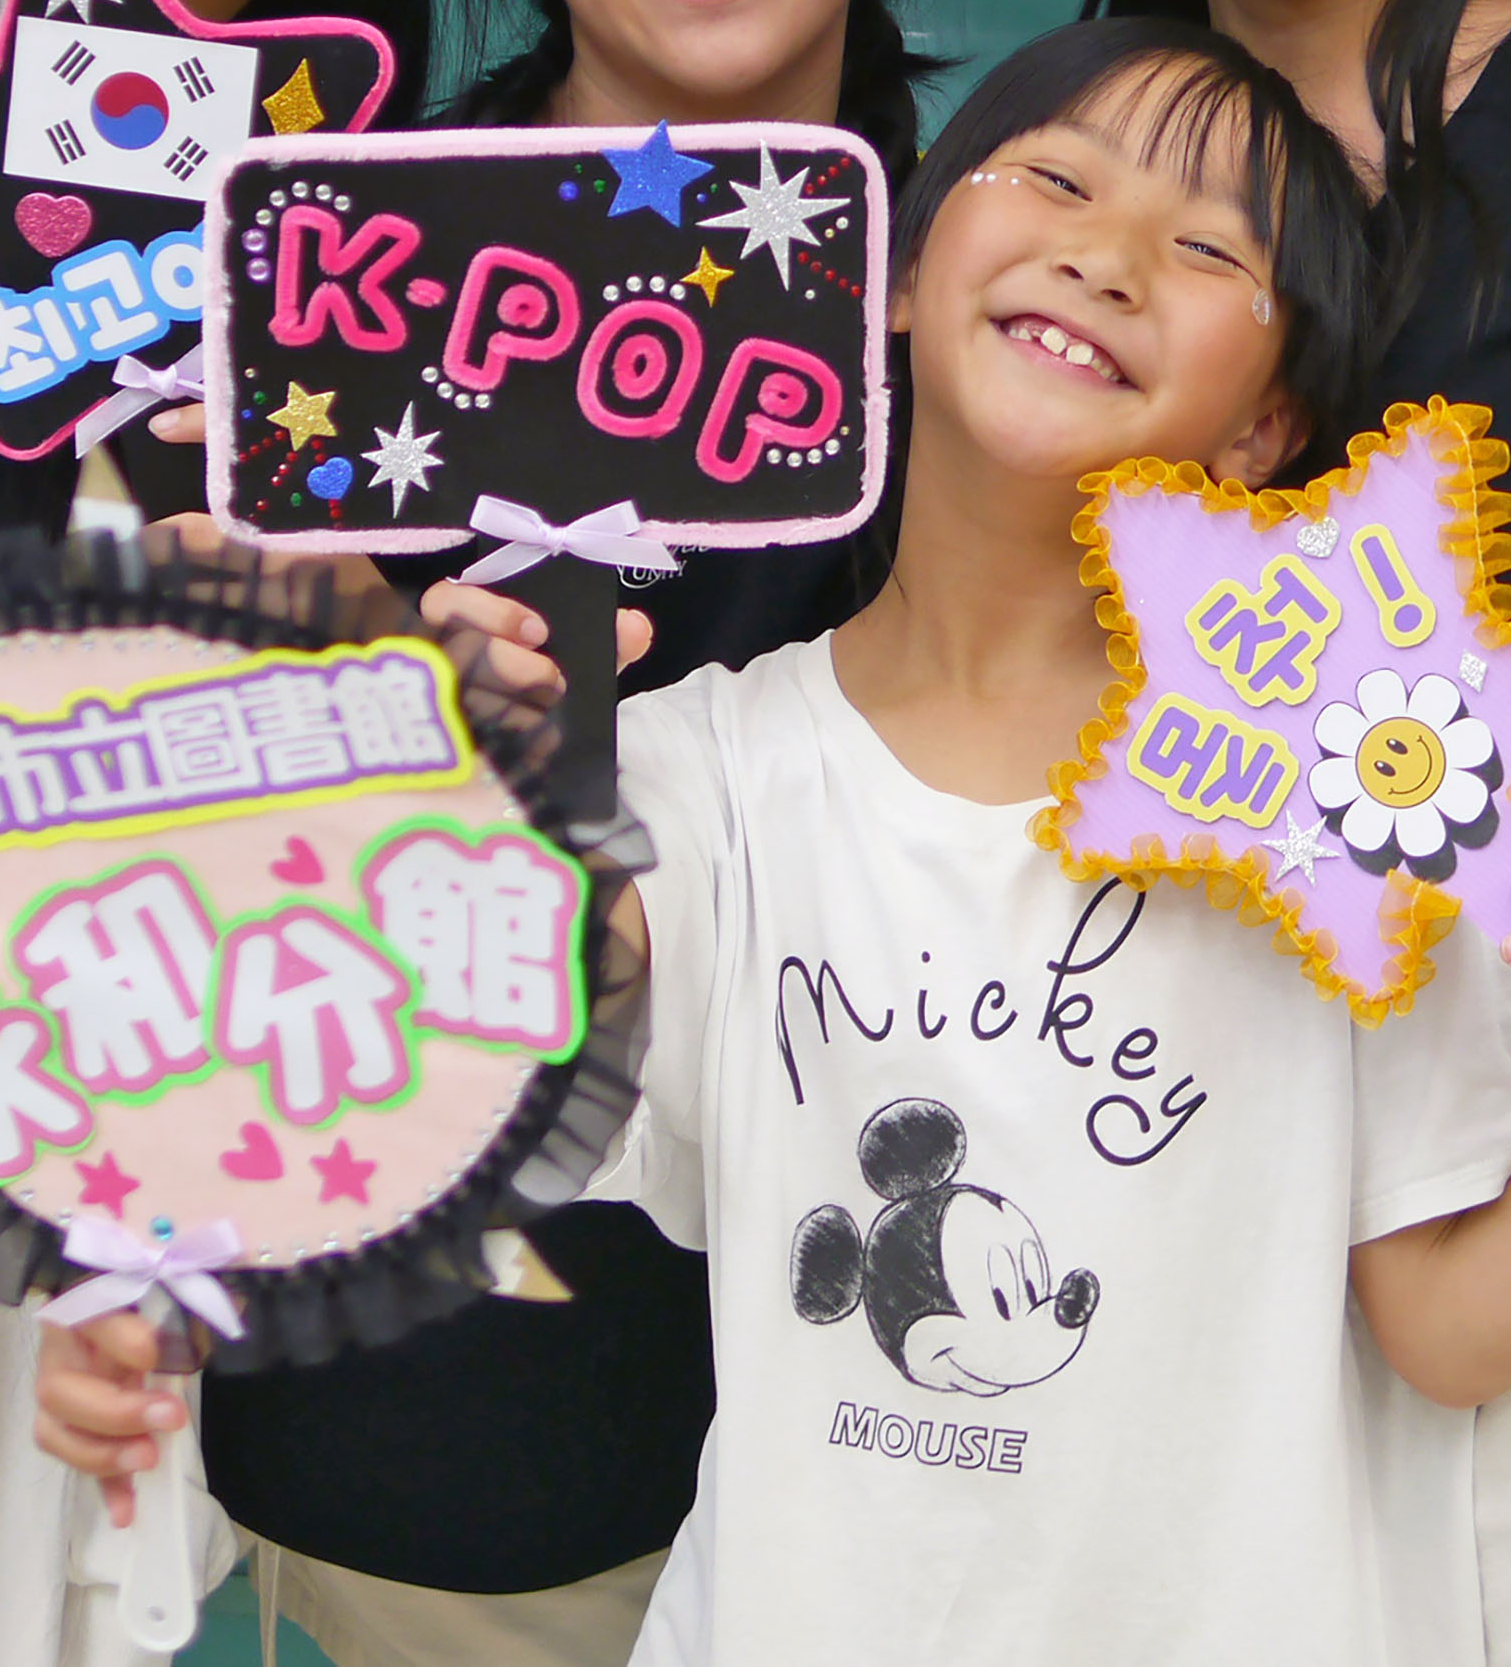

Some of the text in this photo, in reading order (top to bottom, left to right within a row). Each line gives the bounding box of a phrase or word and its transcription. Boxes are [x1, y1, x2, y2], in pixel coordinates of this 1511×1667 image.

[269, 202, 843, 484] K-POP
[775, 876, 1209, 1167] Mickey
[827, 1401, 1029, 1475] MOUSE
